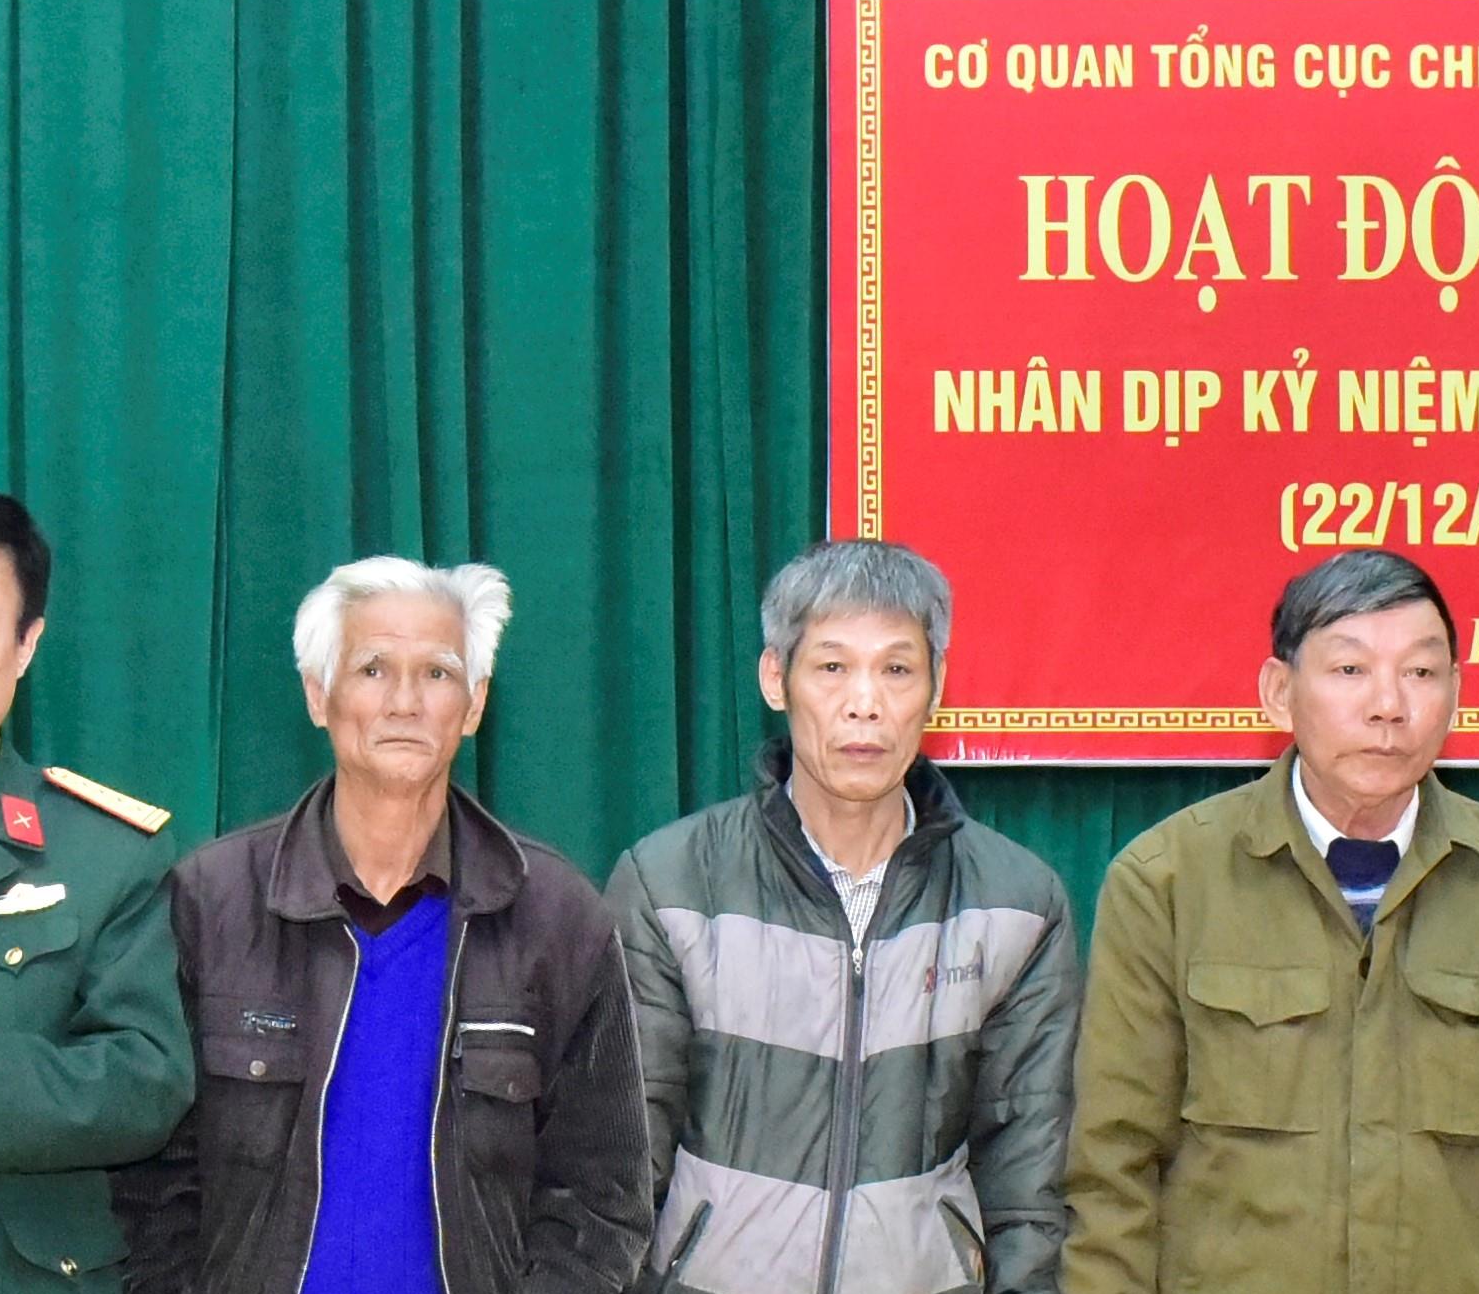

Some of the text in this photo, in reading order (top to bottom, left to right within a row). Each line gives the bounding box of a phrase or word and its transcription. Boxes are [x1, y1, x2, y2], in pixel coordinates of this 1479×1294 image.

[925, 38, 988, 89] CƠ
[1006, 44, 1134, 94] QUAN
[1151, 25, 1276, 89] TỔNG
[1294, 44, 1391, 99] CỤC
[1019, 173, 1310, 313] HOẠT
[935, 356, 1101, 433] NHÂN
[1124, 370, 1221, 447] DỊP
[1244, 348, 1318, 432] KỶ
